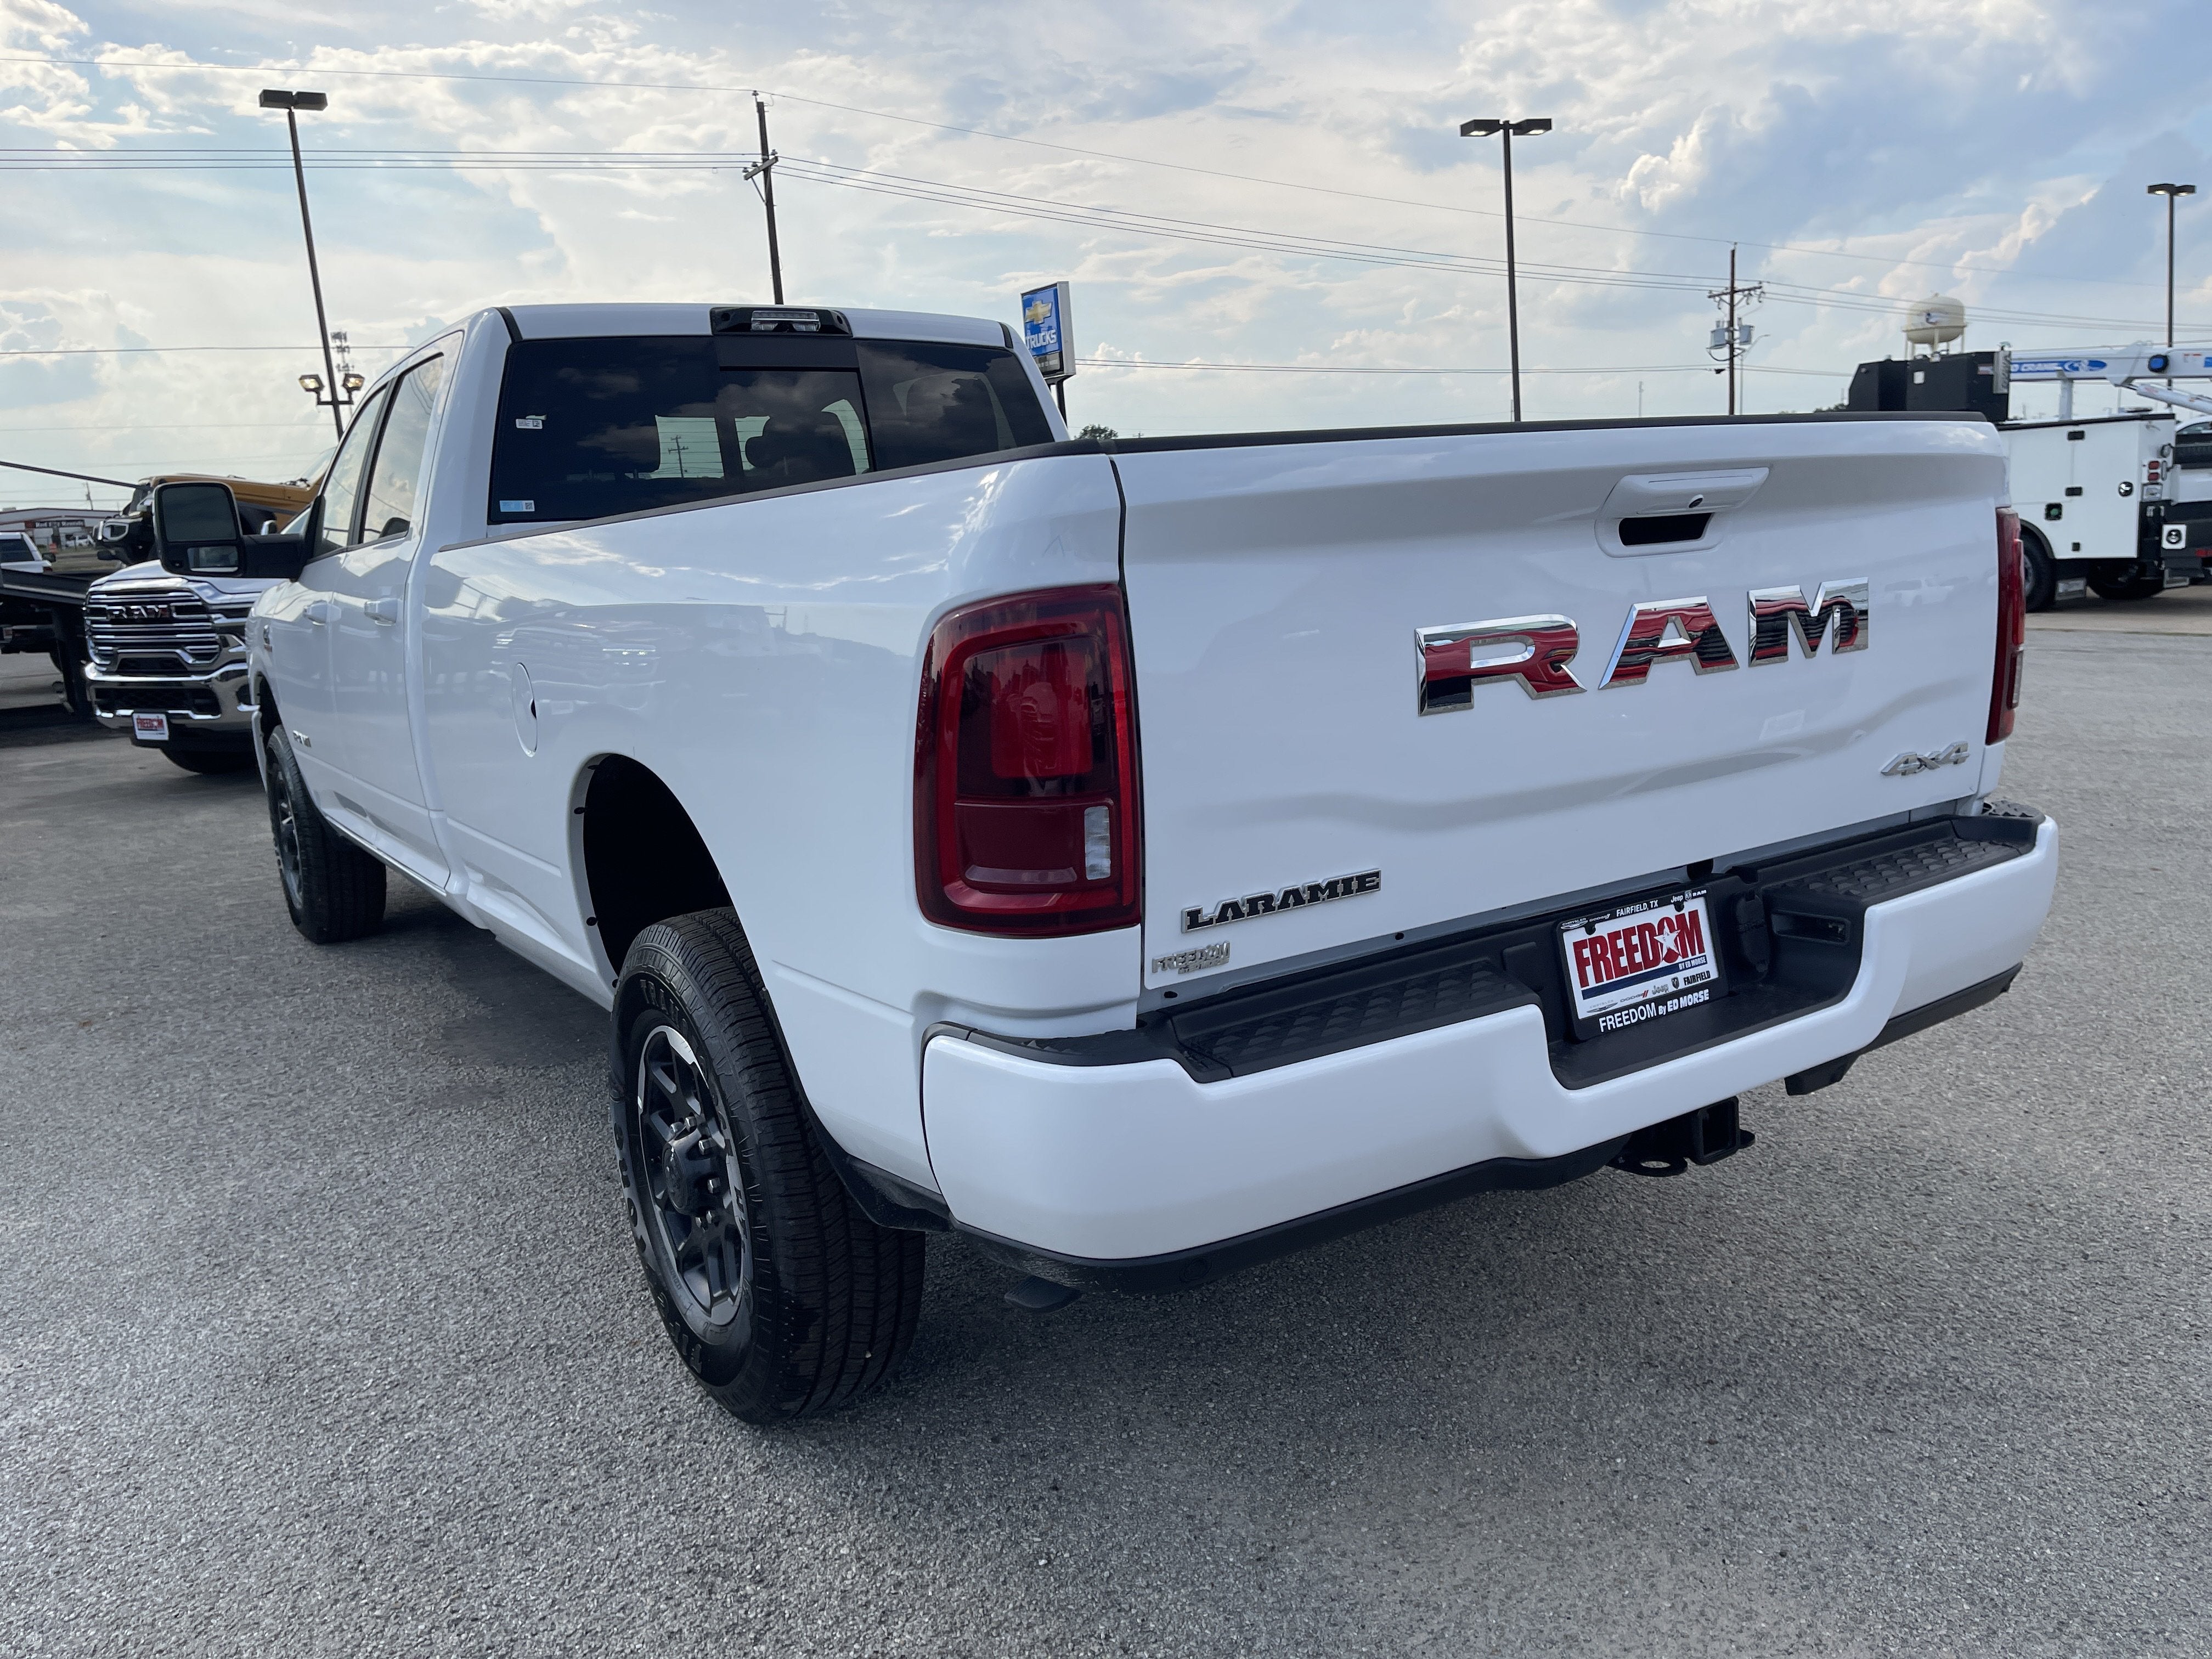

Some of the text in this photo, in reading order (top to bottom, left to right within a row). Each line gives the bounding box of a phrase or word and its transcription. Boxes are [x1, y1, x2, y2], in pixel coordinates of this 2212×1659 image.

[1026, 329, 1057, 349] TRUCKS
[107, 605, 171, 619] RAM
[1414, 576, 1870, 716] RAM
[1181, 868, 1381, 933] LARAMIE
[1671, 895, 1683, 903] Jeep
[1616, 900, 1658, 917] FAIRFIELD, TX
[1152, 940, 1231, 973] FREEDOM
[1573, 909, 1706, 988] FREEDOM
[1679, 957, 1707, 970] BY ED MORSE
[1683, 970, 1711, 986] FAIRFIELD
[1652, 984, 1669, 995] Jeep
[1599, 989, 1709, 1032] FREEDOM By ED MORSE
